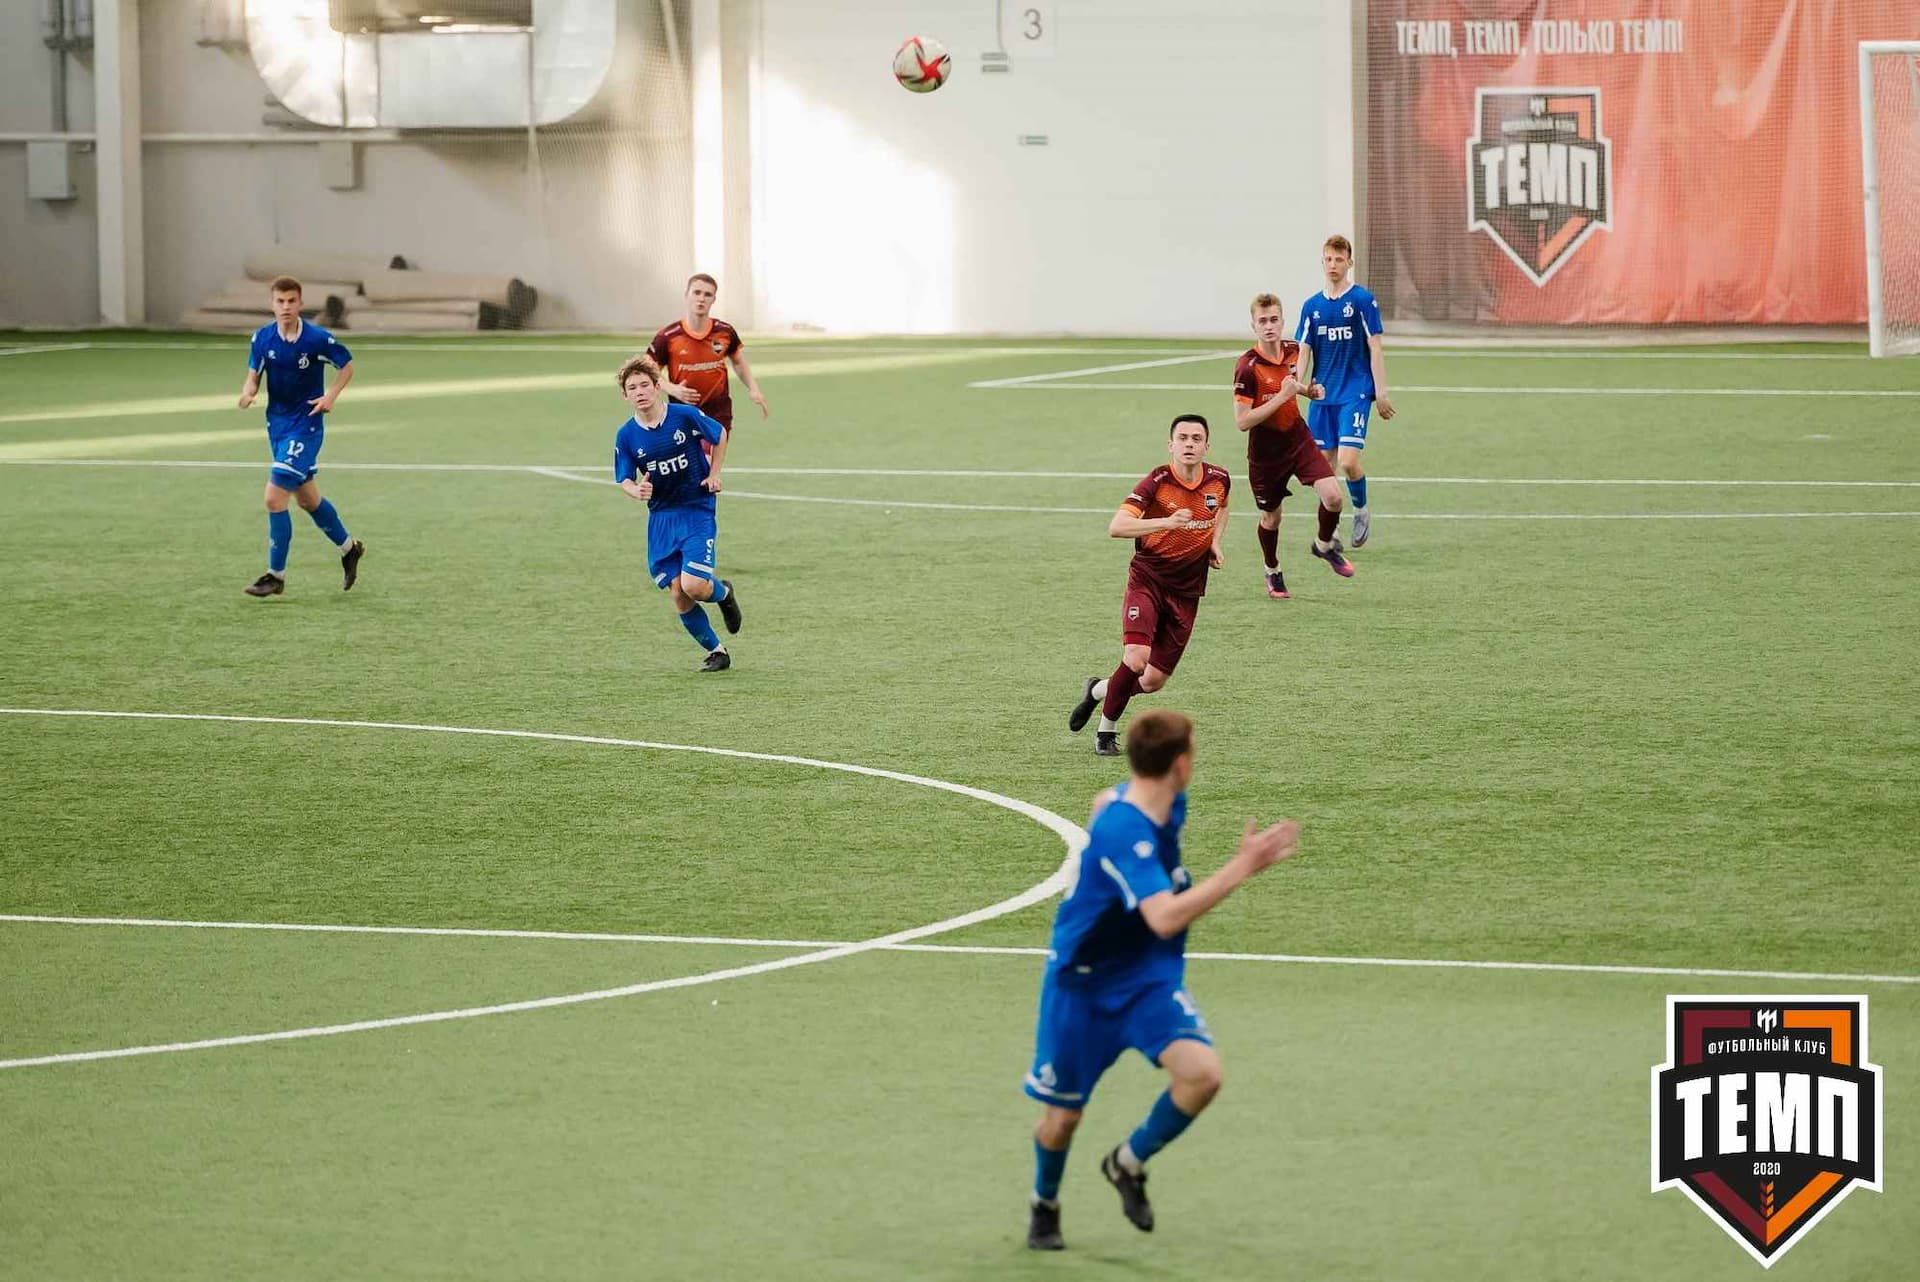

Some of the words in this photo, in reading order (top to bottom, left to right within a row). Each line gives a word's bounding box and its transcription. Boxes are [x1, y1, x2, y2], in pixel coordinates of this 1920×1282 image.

[1023, 8, 1043, 41] 3
[1396, 20, 1458, 58] ТЕМП,
[1532, 19, 1615, 54] ТОЛЬКО
[1480, 142, 1599, 211] ТЕМП
[1327, 326, 1353, 341] ВТБ
[1352, 411, 1365, 429] 14
[286, 439, 305, 458] 12
[658, 453, 689, 476] ВТБ
